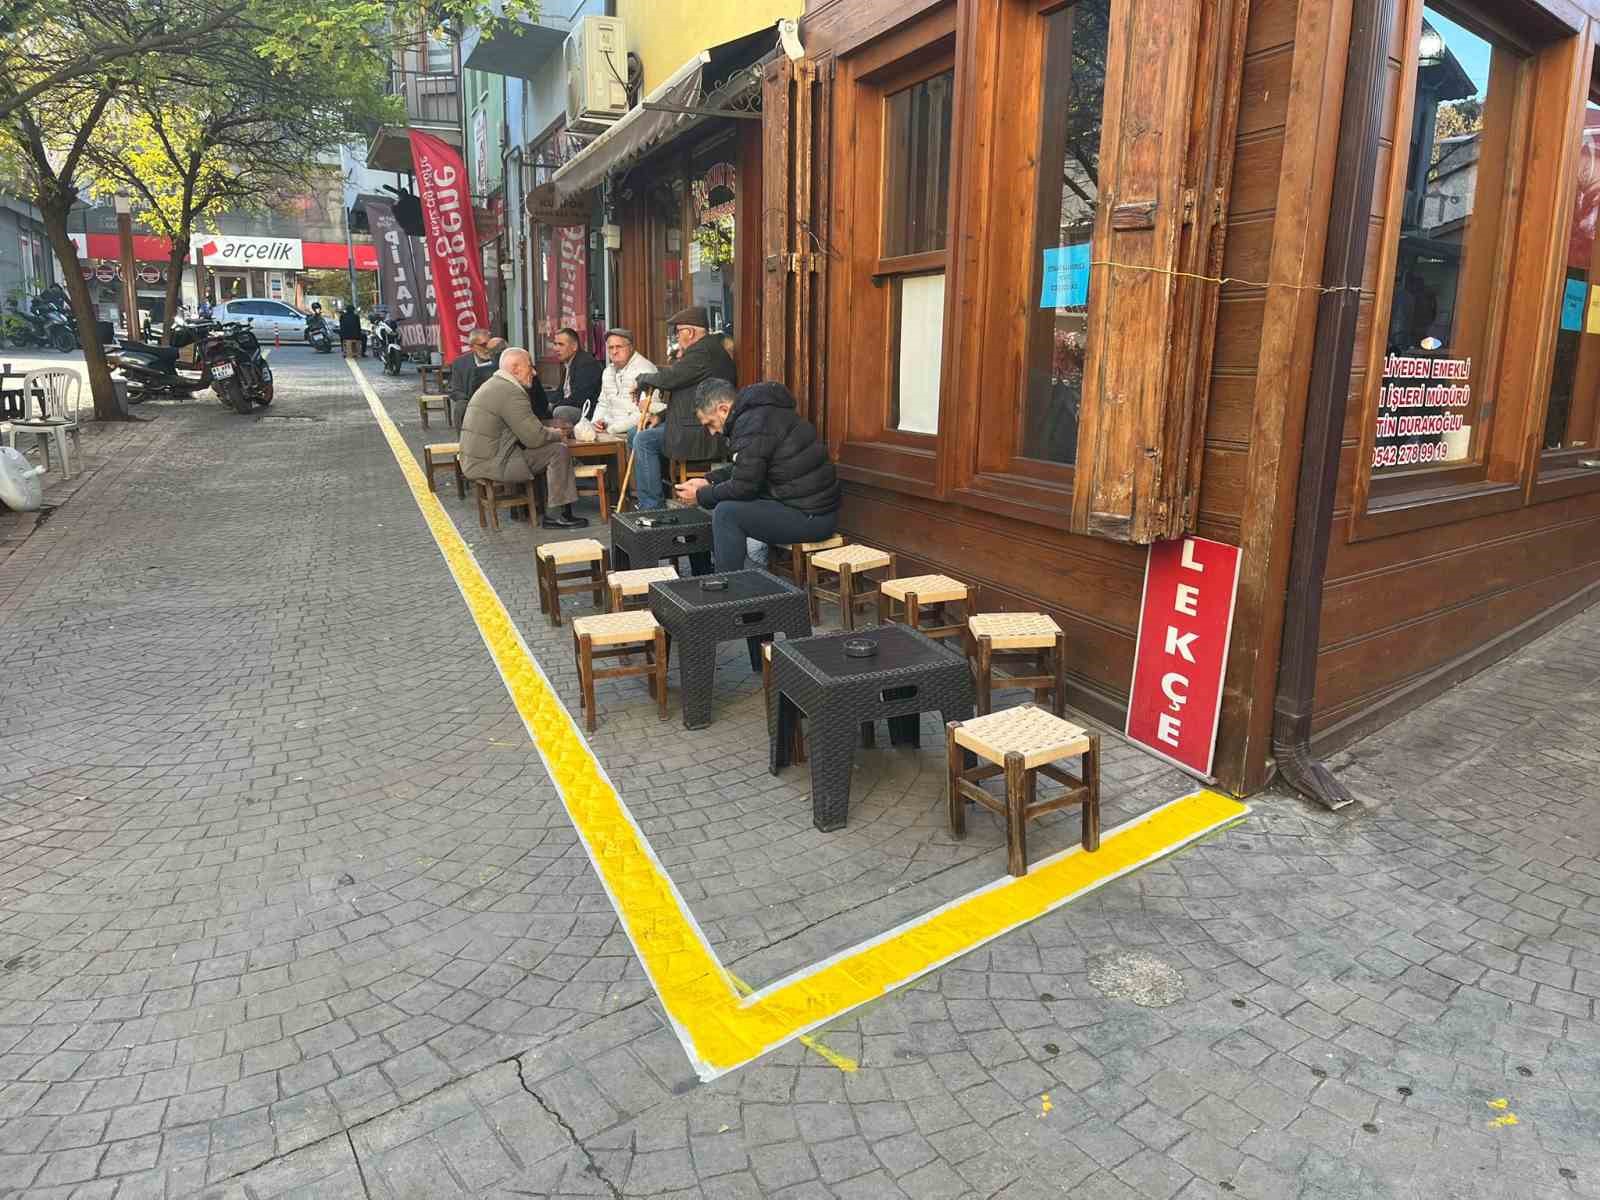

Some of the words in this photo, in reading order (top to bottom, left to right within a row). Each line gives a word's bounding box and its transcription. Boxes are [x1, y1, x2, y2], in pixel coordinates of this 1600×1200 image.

[222, 242, 293, 263] arçelik
[1431, 356, 1471, 379] EMEKLİ
[1386, 382, 1425, 411] İŞLERİ
[1425, 384, 1471, 407] MÜDÜRÜ
[1398, 411, 1463, 436] DURAKOĞLU
[1397, 443, 1420, 464] 278
[1420, 443, 1434, 461] 99
[1434, 441, 1448, 459] 19
[1157, 539, 1204, 748] LEKÇE
